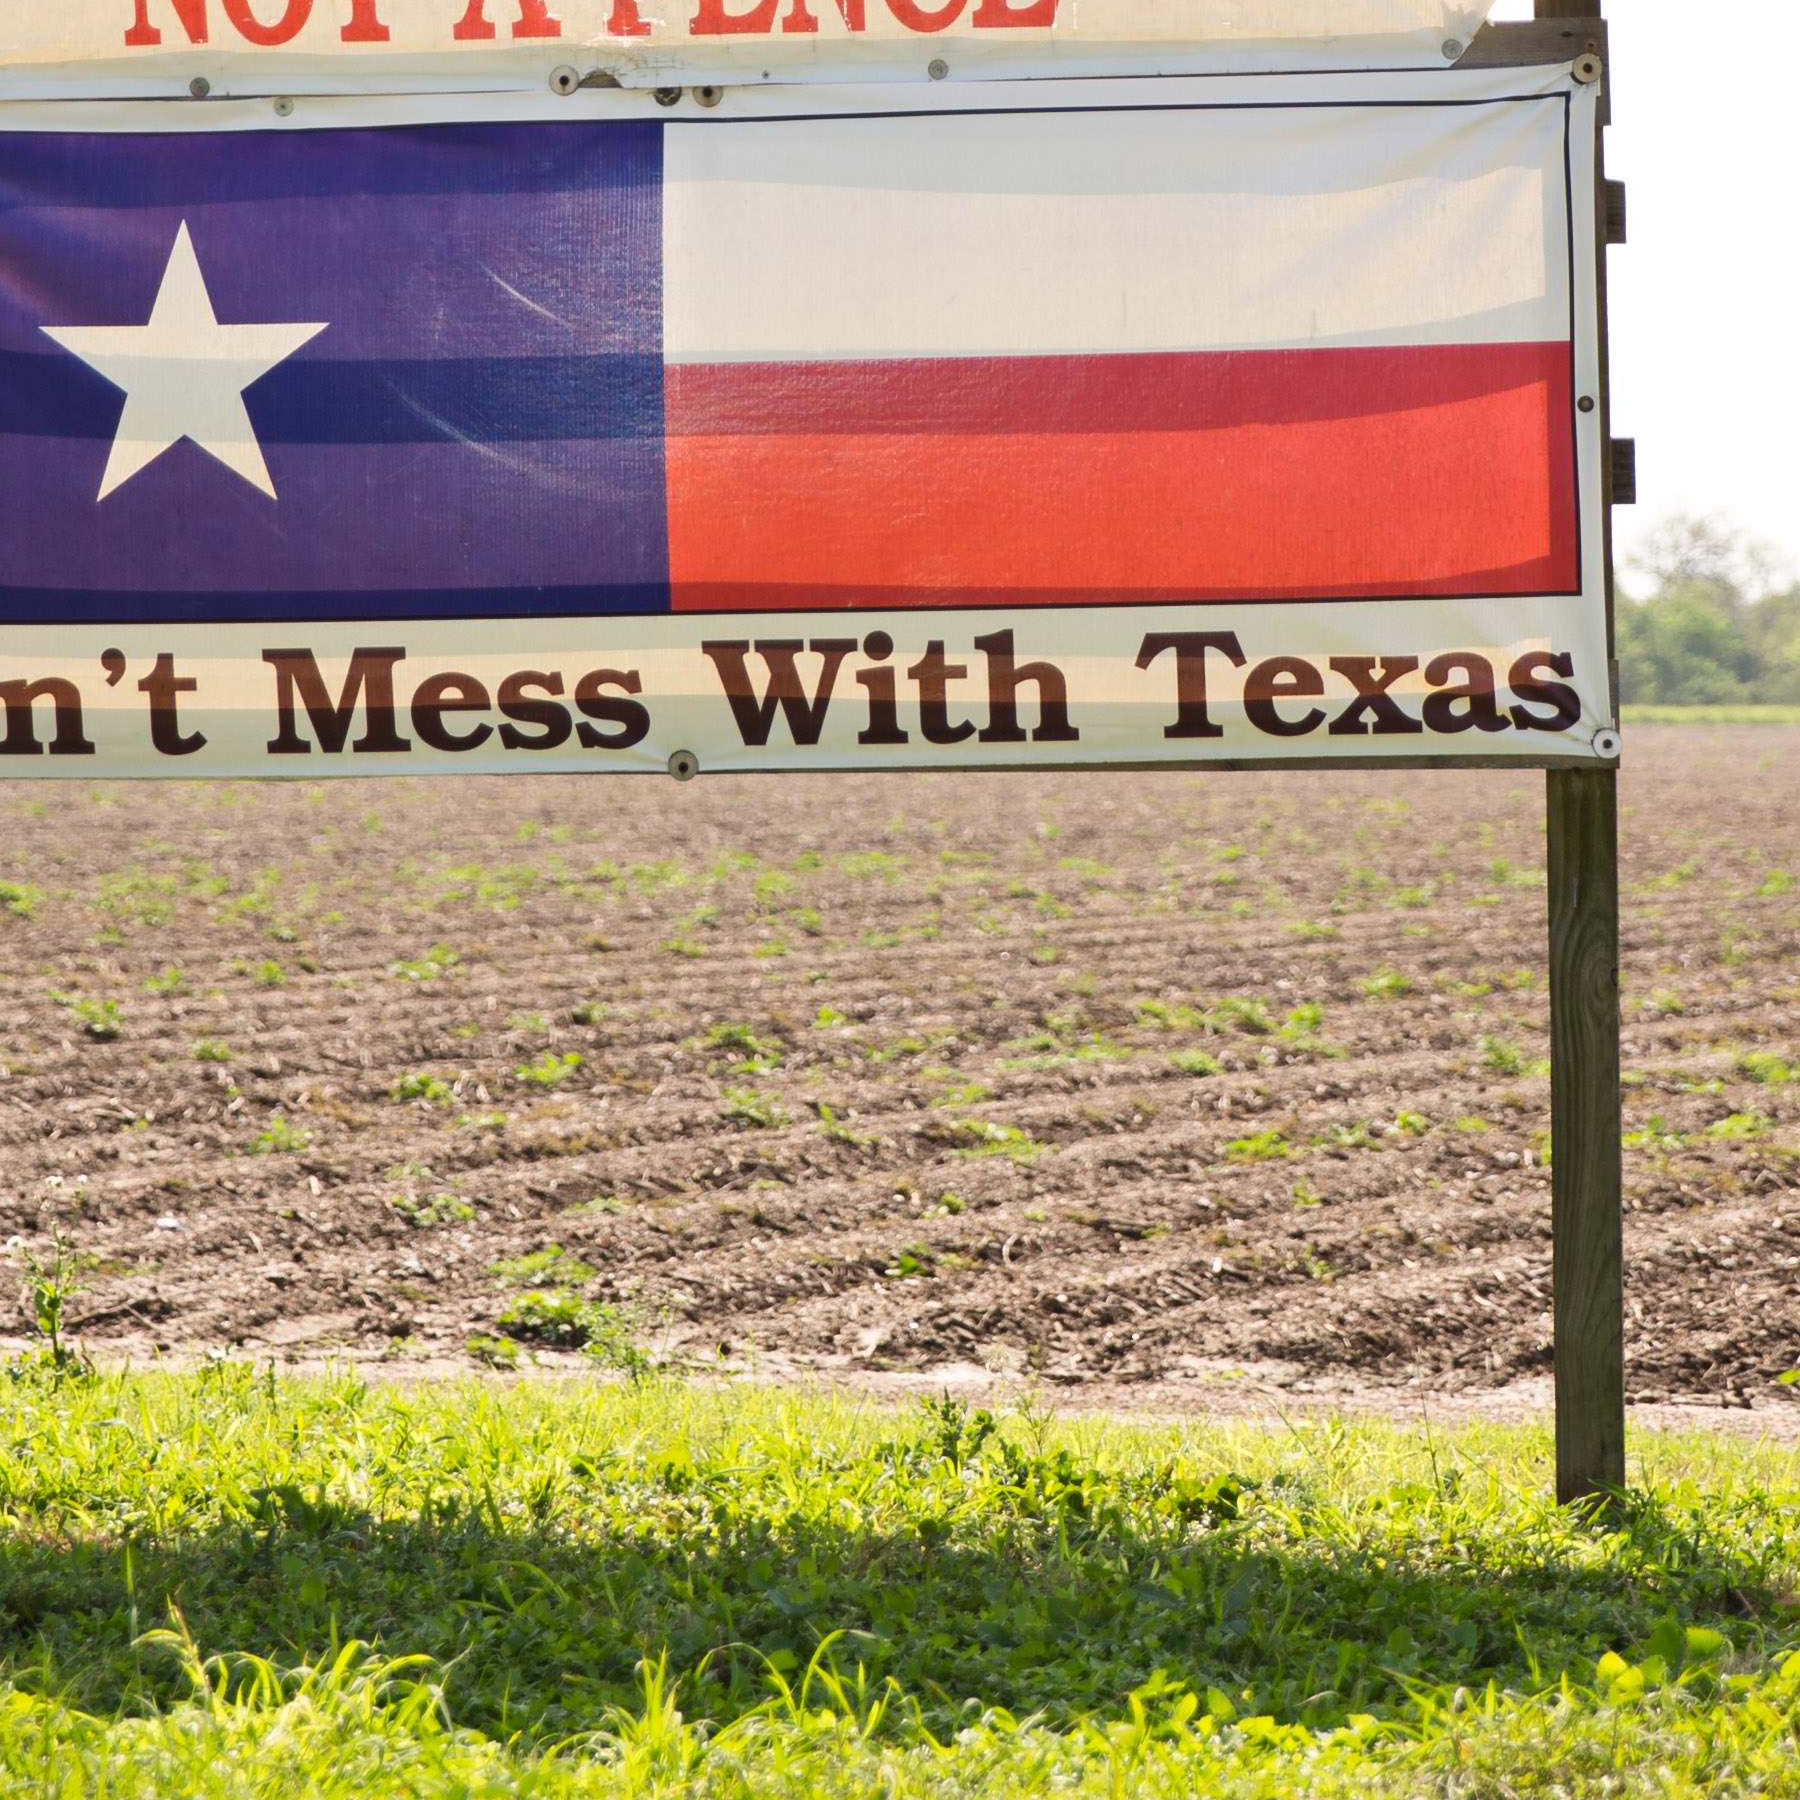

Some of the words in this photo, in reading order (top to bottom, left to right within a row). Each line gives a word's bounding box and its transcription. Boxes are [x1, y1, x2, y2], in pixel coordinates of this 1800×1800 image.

[262, 647, 650, 754] Mess
[702, 629, 1079, 746] With
[1136, 631, 1581, 738] Texas
